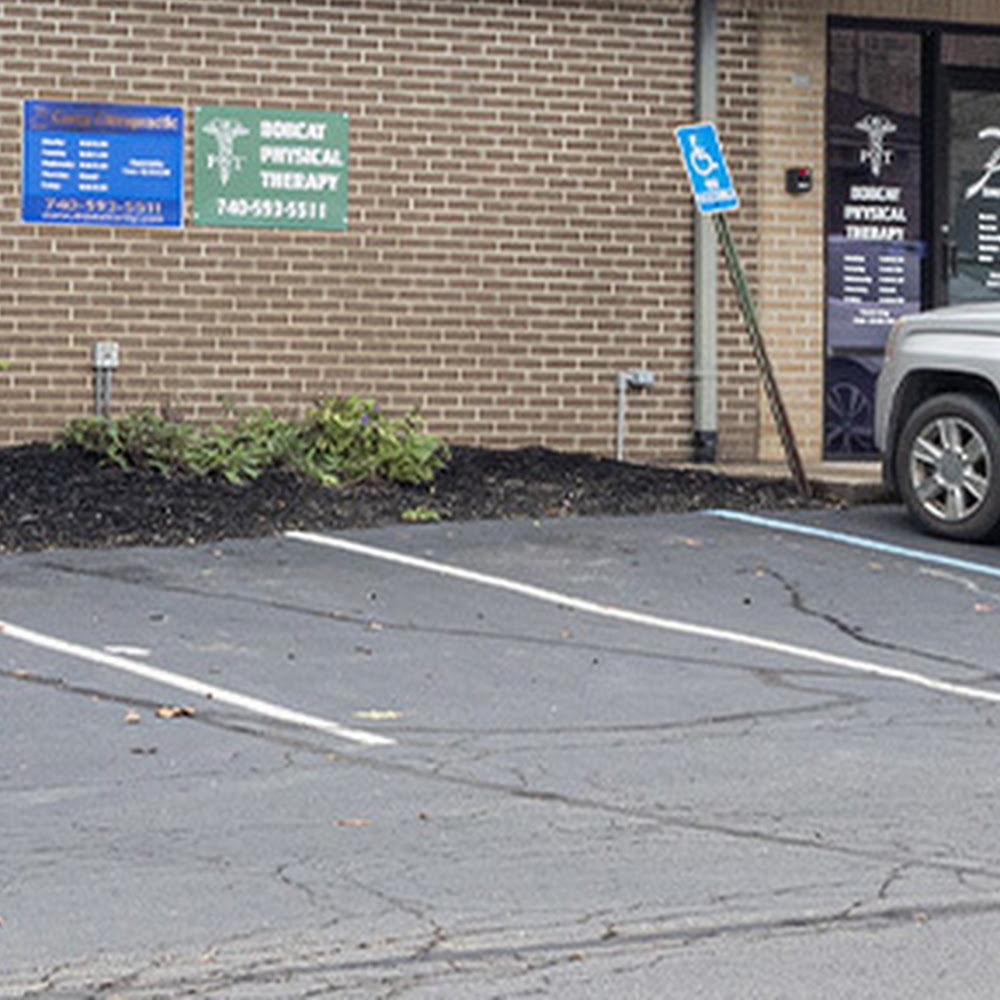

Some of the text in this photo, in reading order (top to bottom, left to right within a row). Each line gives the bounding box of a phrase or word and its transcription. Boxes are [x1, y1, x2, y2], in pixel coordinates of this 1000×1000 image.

[259, 119, 327, 140] BOBCAT
[259, 145, 343, 168] PHYSICAL
[260, 170, 341, 191] THERAPY
[844, 204, 907, 223] PHYSICAL
